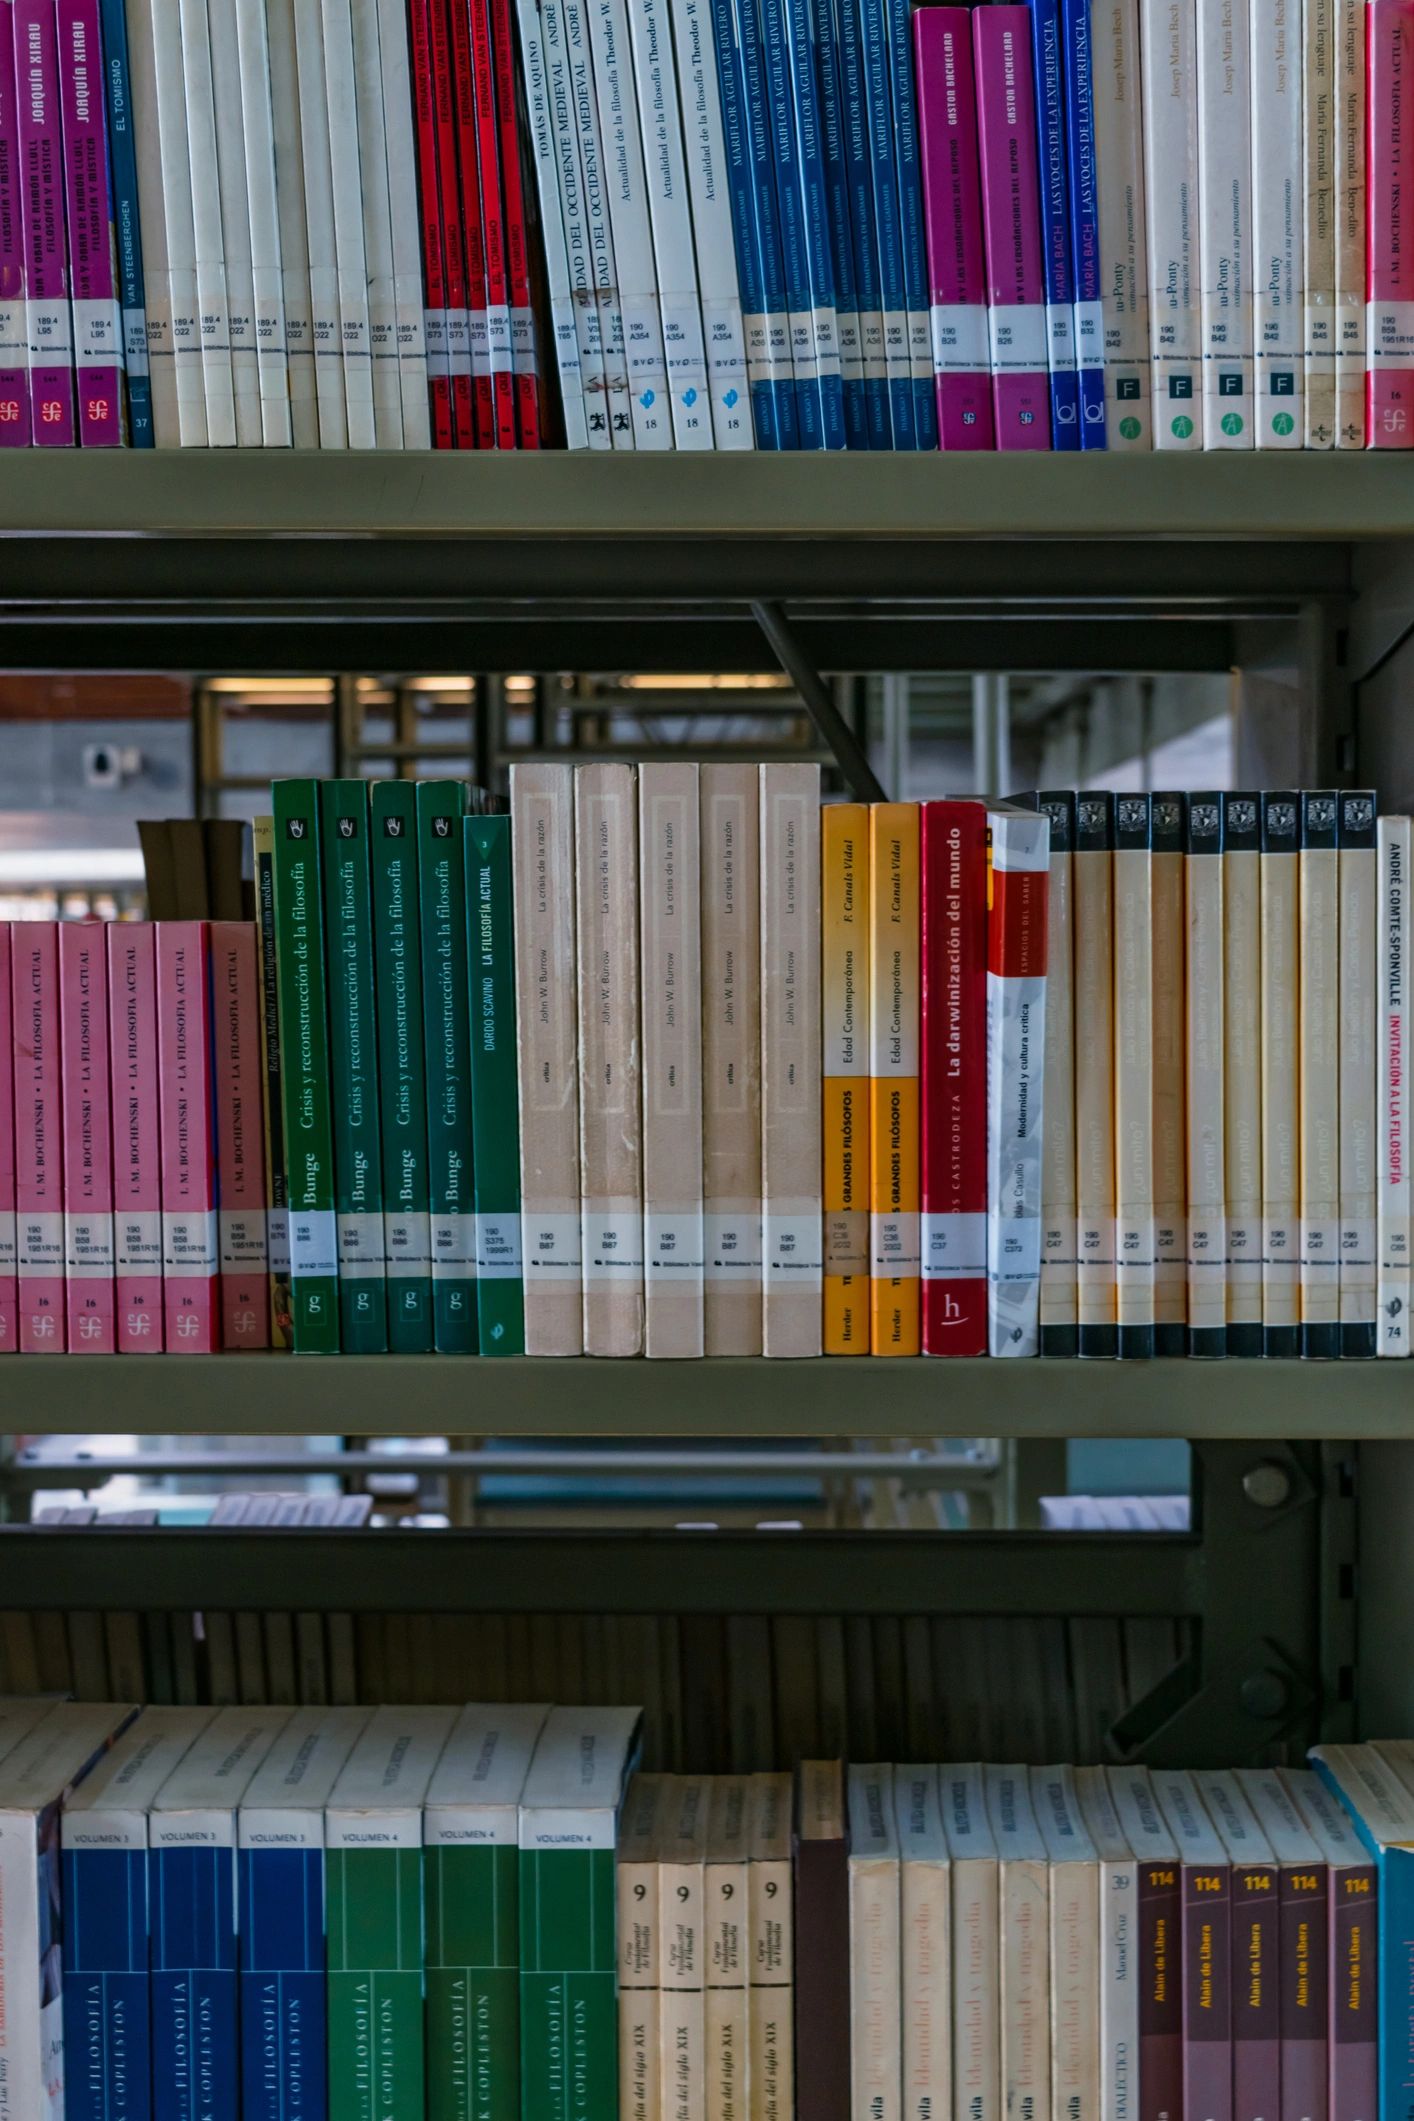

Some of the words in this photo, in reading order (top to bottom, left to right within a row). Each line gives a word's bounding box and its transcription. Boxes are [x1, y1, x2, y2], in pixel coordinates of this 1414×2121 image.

[716, 5, 730, 48] RIVERO
[1167, 4, 1180, 31] Bech
[28, 23, 42, 64] XIRAU
[72, 21, 87, 62] XIRAU
[601, 19, 617, 67] Theodor
[689, 18, 702, 66] Theodor
[944, 32, 957, 86] BACHELARD
[1003, 31, 1014, 86] BACHELARD
[1315, 29, 1328, 76] lenguaje
[1391, 28, 1402, 76] ACTUAL
[528, 40, 543, 90] AQUINO
[721, 51, 737, 102] AGUILAR
[772, 47, 786, 98] AGUILAR
[1043, 19, 1058, 105] EXPERIENCIA
[28, 68, 45, 125] JOAQUÍN
[72, 67, 90, 123] JOAQUÍN
[111, 59, 124, 114] TOMISMO
[535, 94, 545, 110] DE
[551, 60, 570, 131] MEDIEVAL
[574, 60, 592, 132] MEDIEVAL
[947, 89, 958, 125] GASTON
[1006, 88, 1017, 124] GASTON
[1047, 109, 1059, 125] LA
[116, 117, 126, 131] EL
[536, 112, 550, 160] TOMÁS
[614, 128, 625, 142] de
[726, 105, 744, 166] MARIFLOR
[774, 102, 791, 162] MARIFLOR
[1048, 127, 1060, 145] DE
[615, 144, 630, 201] Actualidad
[702, 144, 716, 201] Actualidad
[1050, 147, 1061, 191] VOCES
[1080, 145, 1092, 188] VOCES
[1317, 129, 1328, 181] Fernanda
[1391, 148, 1401, 164] LA
[560, 137, 580, 217] OCCIDENTE
[583, 138, 603, 217] OCCIDENTE
[1052, 192, 1063, 215] LAS
[1230, 179, 1243, 237] pensamiento
[1317, 188, 1328, 240] Benedito
[1391, 184, 1401, 254] BOCHENSKI
[121, 200, 135, 279] STEENBERGHEN
[571, 222, 583, 249] DEL
[594, 223, 606, 250] DEL
[1054, 225, 1065, 258] BACH
[127, 284, 135, 303] VAN
[1053, 261, 1067, 299] MARÍA
[90, 330, 105, 338] L95
[174, 318, 194, 326] 189.4
[343, 322, 363, 330] 189.4
[630, 323, 643, 331] 190
[630, 332, 649, 340] A354
[135, 418, 147, 427] 37
[646, 420, 657, 429] 18
[728, 420, 739, 428] 18
[537, 819, 545, 846] razón
[537, 860, 545, 872] de
[844, 840, 853, 870] Vidal
[946, 828, 960, 889] mundo
[1390, 843, 1402, 885] ANDRÉ
[290, 862, 307, 921] filosofía
[340, 861, 356, 918] filosofía
[389, 860, 404, 918] filosofía
[480, 866, 491, 899] ACTUAL
[538, 875, 546, 900] crisis
[725, 876, 733, 901] crisis
[843, 873, 853, 913] Canals
[539, 901, 546, 913] La
[946, 893, 960, 921] del
[293, 925, 307, 938] la
[478, 903, 493, 952] FILOSOFÍA
[294, 941, 308, 960] de
[482, 954, 493, 965] LA
[1021, 928, 1029, 973] ESPACIOS
[1389, 887, 1401, 1006] COMTE-SPONVILLE
[32, 949, 42, 995] ACTUAL
[126, 946, 136, 993] ACTUAL
[540, 949, 548, 982] Burrow
[725, 951, 733, 984] Burrow
[484, 977, 494, 1016] SCAVINO
[946, 926, 960, 1053] darwinización
[127, 998, 138, 1059] FILOSOFIA
[295, 963, 312, 1072] reconstrucción
[541, 1001, 549, 1024] John
[725, 1003, 733, 1026] John
[32, 1000, 43, 1062] FILOSOFIA
[484, 1018, 495, 1051] DARDO
[843, 1037, 853, 1063] Edad
[1020, 1036, 1029, 1071] cultura
[1390, 1015, 1402, 1086] INVITACIÓN
[33, 1065, 43, 1080] LA
[947, 1060, 960, 1077] La
[298, 1087, 314, 1129] Crisis
[348, 1085, 363, 1126] Crisis
[396, 1084, 411, 1126] Crisis
[840, 1090, 852, 1149] FILÓSOFOS
[1017, 1082, 1028, 1138] Modernidad
[1390, 1101, 1401, 1118] LA
[35, 1099, 45, 1166] BOCHENSKI
[130, 1097, 140, 1164] BOCHENSKI
[952, 1095, 960, 1191] CASTRODEZA
[1390, 1121, 1404, 1184] FILOSOFÍA
[303, 1153, 320, 1204] Bunge
[352, 1151, 369, 1201] Bunge
[400, 1150, 416, 1200] Bunge
[843, 1152, 852, 1209] GRANDES
[1013, 1163, 1024, 1197] Casullo
[1231, 1239, 1246, 1248] C47
[309, 1295, 321, 1313] g
[358, 1292, 369, 1310] g
[843, 1307, 851, 1341] Herder
[1388, 1327, 1401, 1337] 74
[73, 1835, 121, 1843] VOLUMEN
[160, 1832, 208, 1841] VOLUMEN
[342, 1833, 390, 1842] VOLUMEN
[536, 1834, 584, 1843] VOLUMEN
[634, 1885, 646, 1900] 9
[677, 1886, 690, 1902] 9
[722, 1884, 734, 1900] 9
[765, 1882, 777, 1899] 9
[1149, 1871, 1174, 1886] 114
[1244, 1876, 1270, 1890] 114
[1345, 1878, 1370, 1892] 114
[1115, 1913, 1128, 1938] Cruz
[1156, 1919, 1165, 1956] Libera
[1250, 1924, 1261, 1958] Libera
[1115, 1940, 1128, 1981] Manuel
[1350, 1927, 1361, 1962] Libera
[1155, 1974, 1165, 2002] Alain
[1250, 1978, 1261, 2007] Alain
[1350, 1981, 1361, 2010] Alain
[676, 2027, 688, 2049] XIX
[765, 2022, 776, 2045] XIX
[113, 2000, 126, 2106] COPLESTON
[382, 1999, 393, 2104] COPLESTON
[676, 2053, 690, 2081] siglo
[765, 2049, 778, 2075] siglo
[676, 2083, 688, 2103] del
[765, 2078, 777, 2099] del
